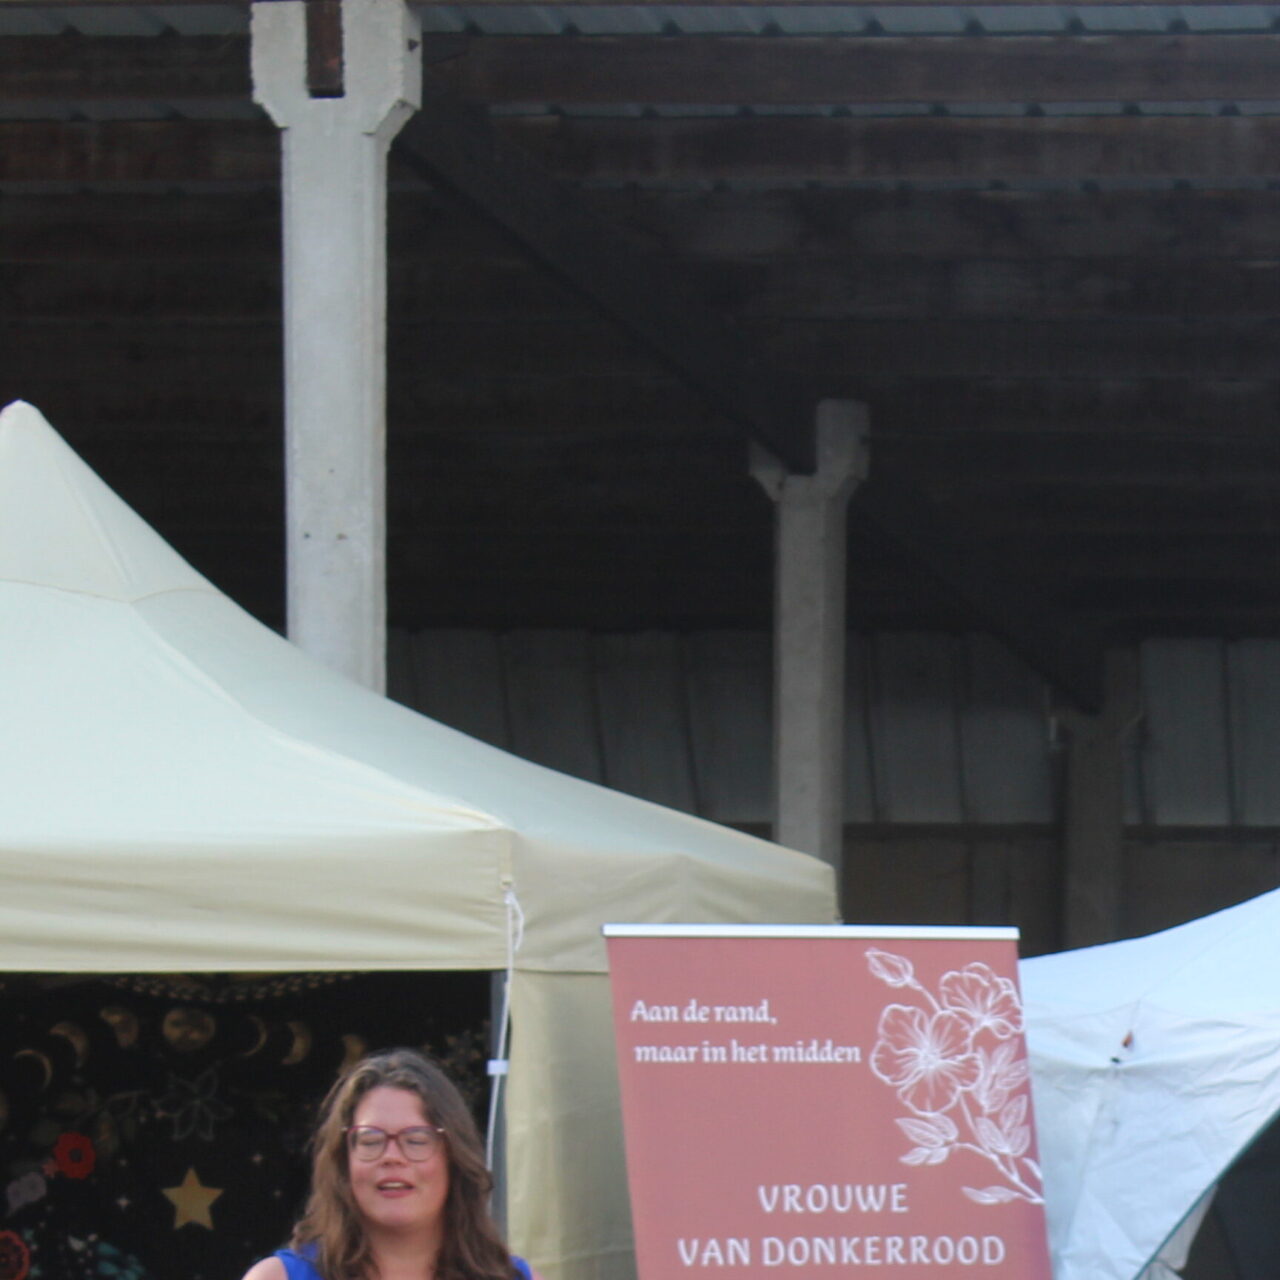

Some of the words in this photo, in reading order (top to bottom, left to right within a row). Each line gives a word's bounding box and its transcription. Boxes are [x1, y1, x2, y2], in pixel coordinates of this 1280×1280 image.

[630, 999, 680, 1023] Aan
[682, 998, 711, 1023] de
[713, 998, 778, 1025] rand,
[634, 1045, 699, 1063] maar
[701, 1040, 728, 1063] in
[731, 1039, 769, 1064] het
[771, 1039, 862, 1064] midden
[758, 1183, 909, 1214] VROUWE
[677, 1237, 751, 1267] VAN
[762, 1235, 1006, 1267] DONKERROOD
